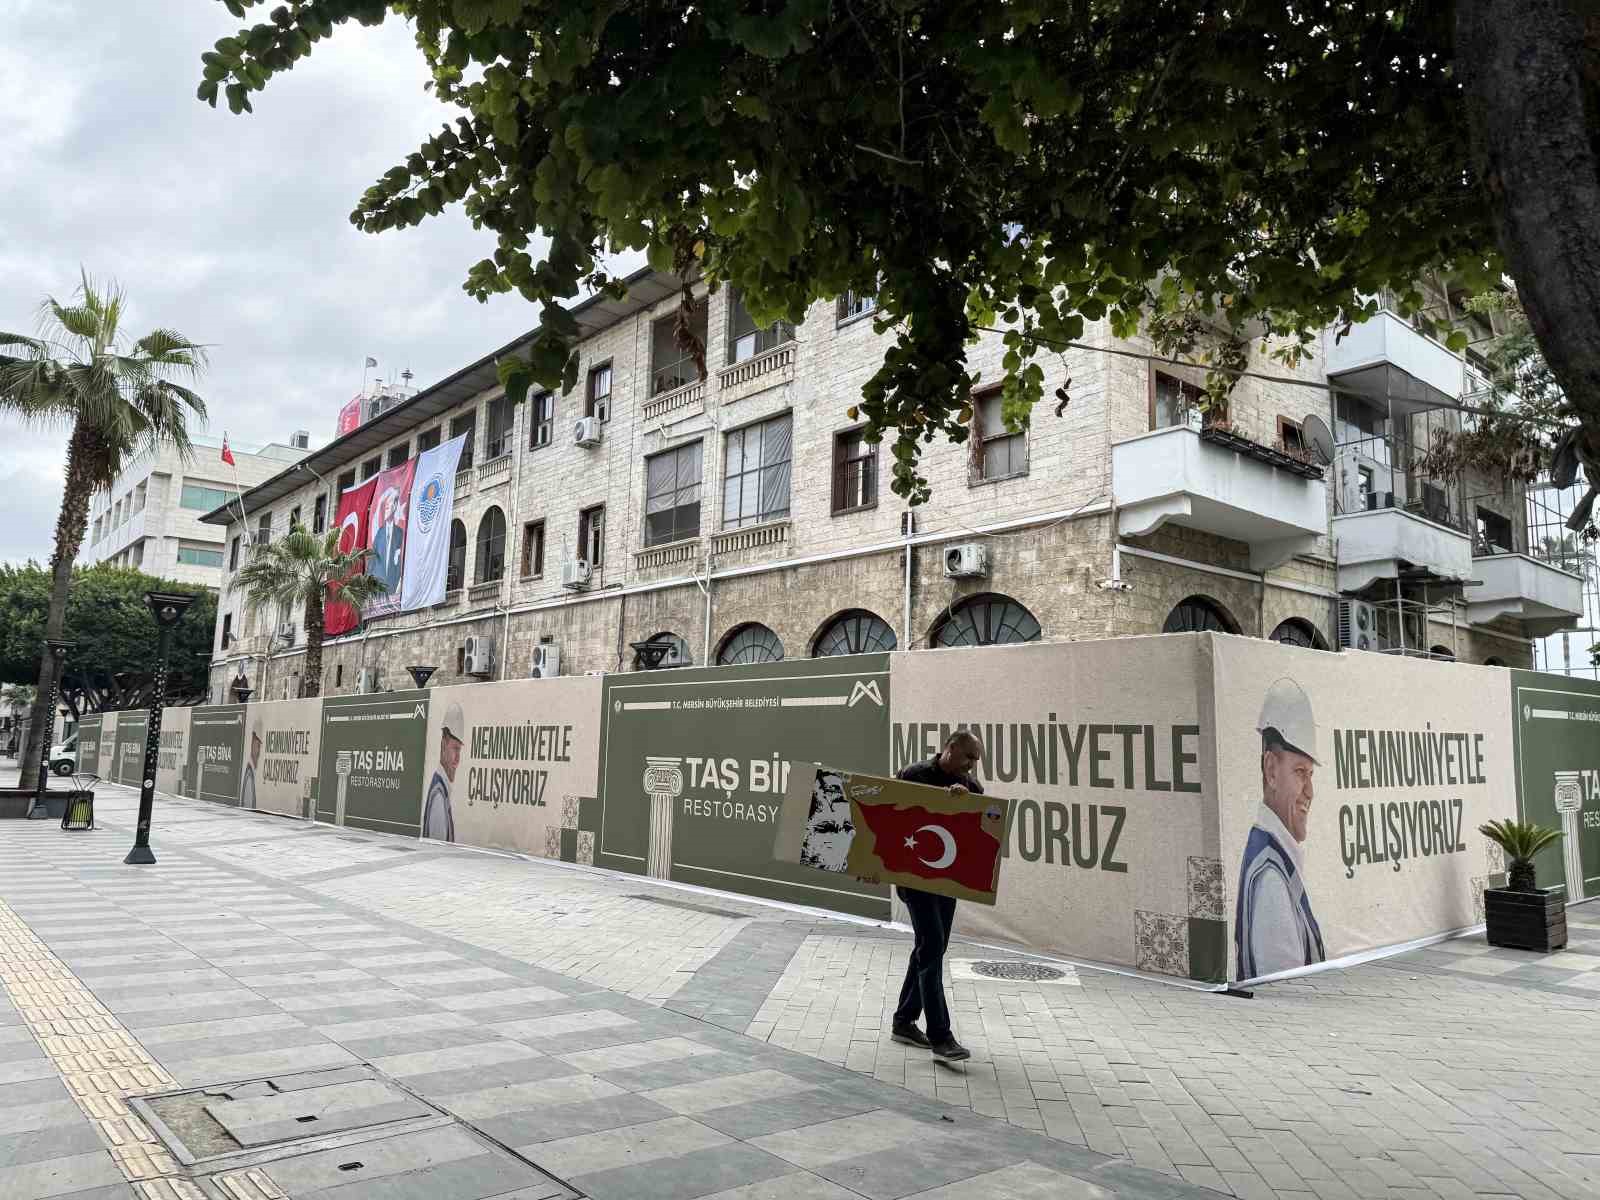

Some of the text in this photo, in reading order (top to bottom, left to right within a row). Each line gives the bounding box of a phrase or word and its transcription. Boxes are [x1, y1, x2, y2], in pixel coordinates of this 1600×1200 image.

[705, 697, 743, 710] BÜYÜKŞEHİR
[744, 696, 779, 708] BELEDİYESİ
[353, 746, 404, 775] TAŞ BİNA
[470, 720, 572, 762] MEMNUNİYETLE
[1333, 722, 1486, 789] MEMNUNİYETLE
[351, 776, 400, 789] RESTORASYONU
[468, 767, 548, 808] ÇALIŞIYORUZ
[686, 758, 739, 799] TAŞ
[1339, 799, 1466, 879] ÇALIŞIYORUZ
